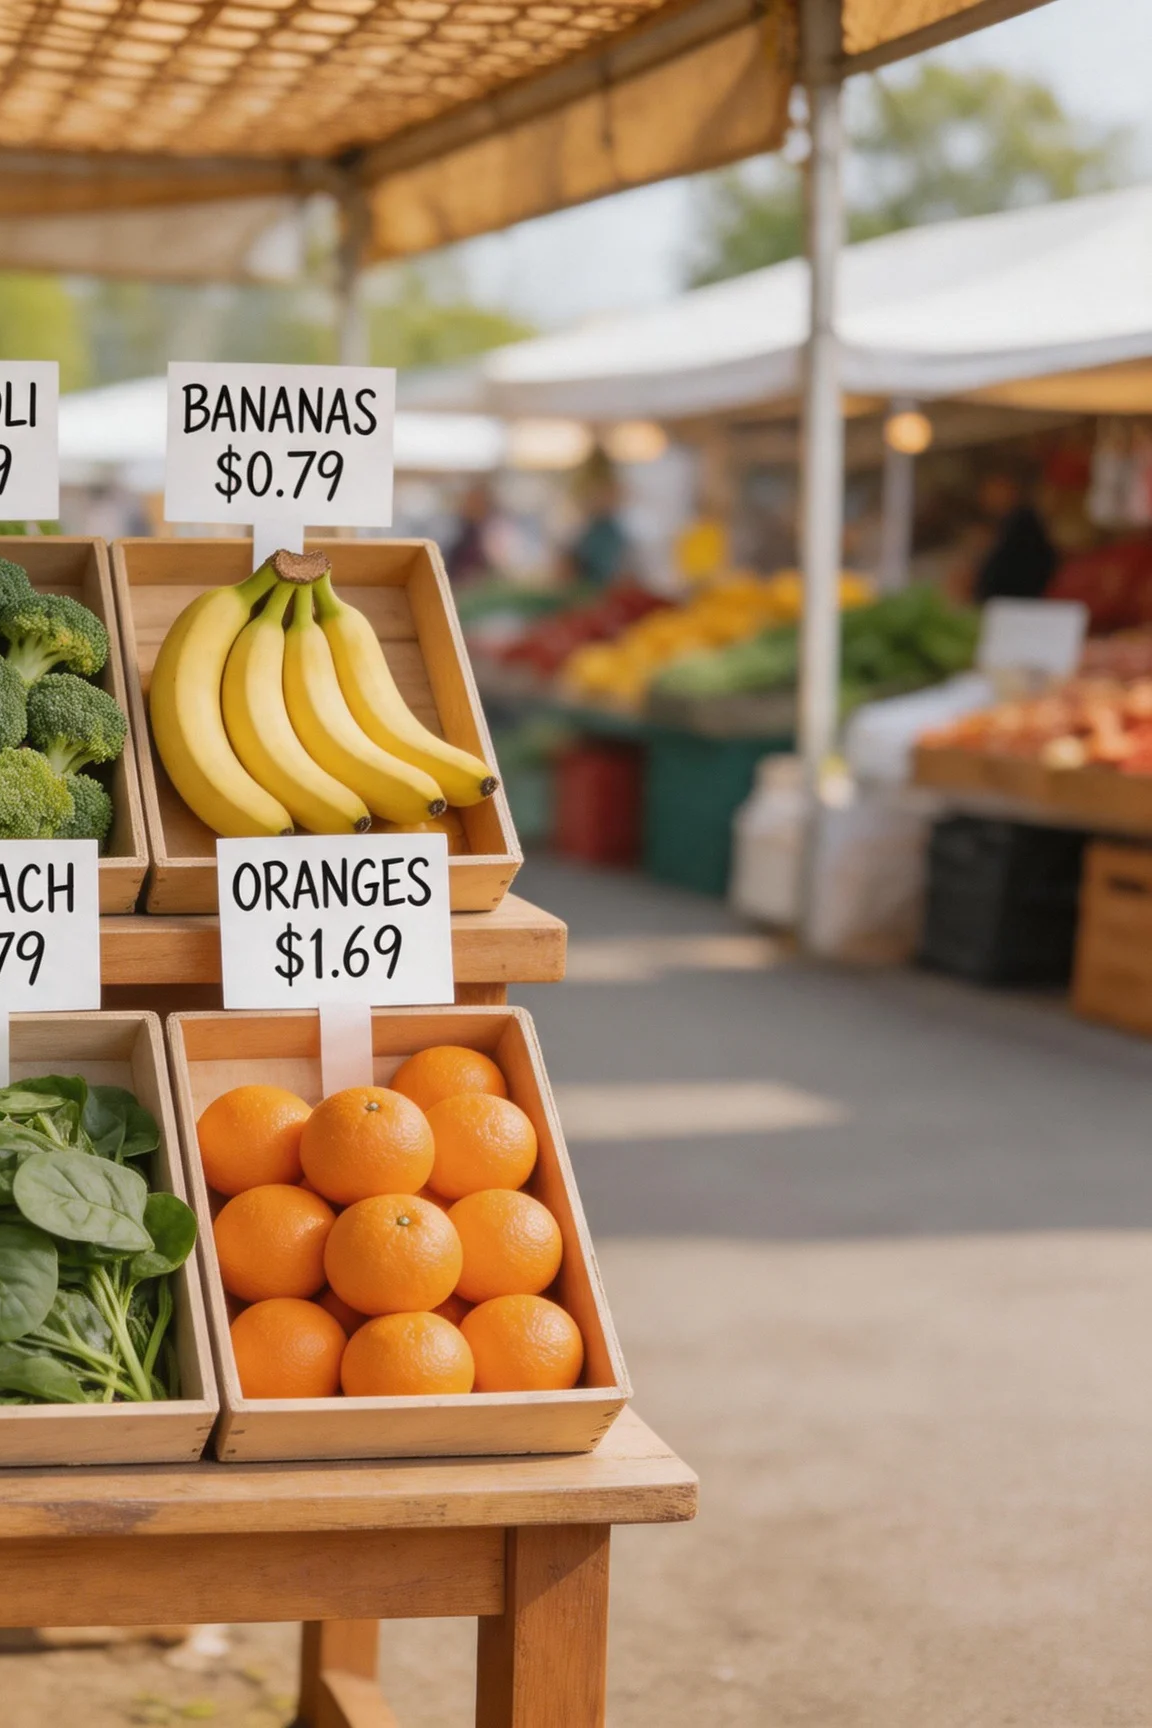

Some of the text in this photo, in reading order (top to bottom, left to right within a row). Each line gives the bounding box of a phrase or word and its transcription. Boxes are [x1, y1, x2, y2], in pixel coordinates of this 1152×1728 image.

[182, 383, 377, 436] BANANAS
[214, 443, 344, 504] $0.79
[232, 856, 432, 912] ORANGES
[274, 922, 402, 987] $1.69
